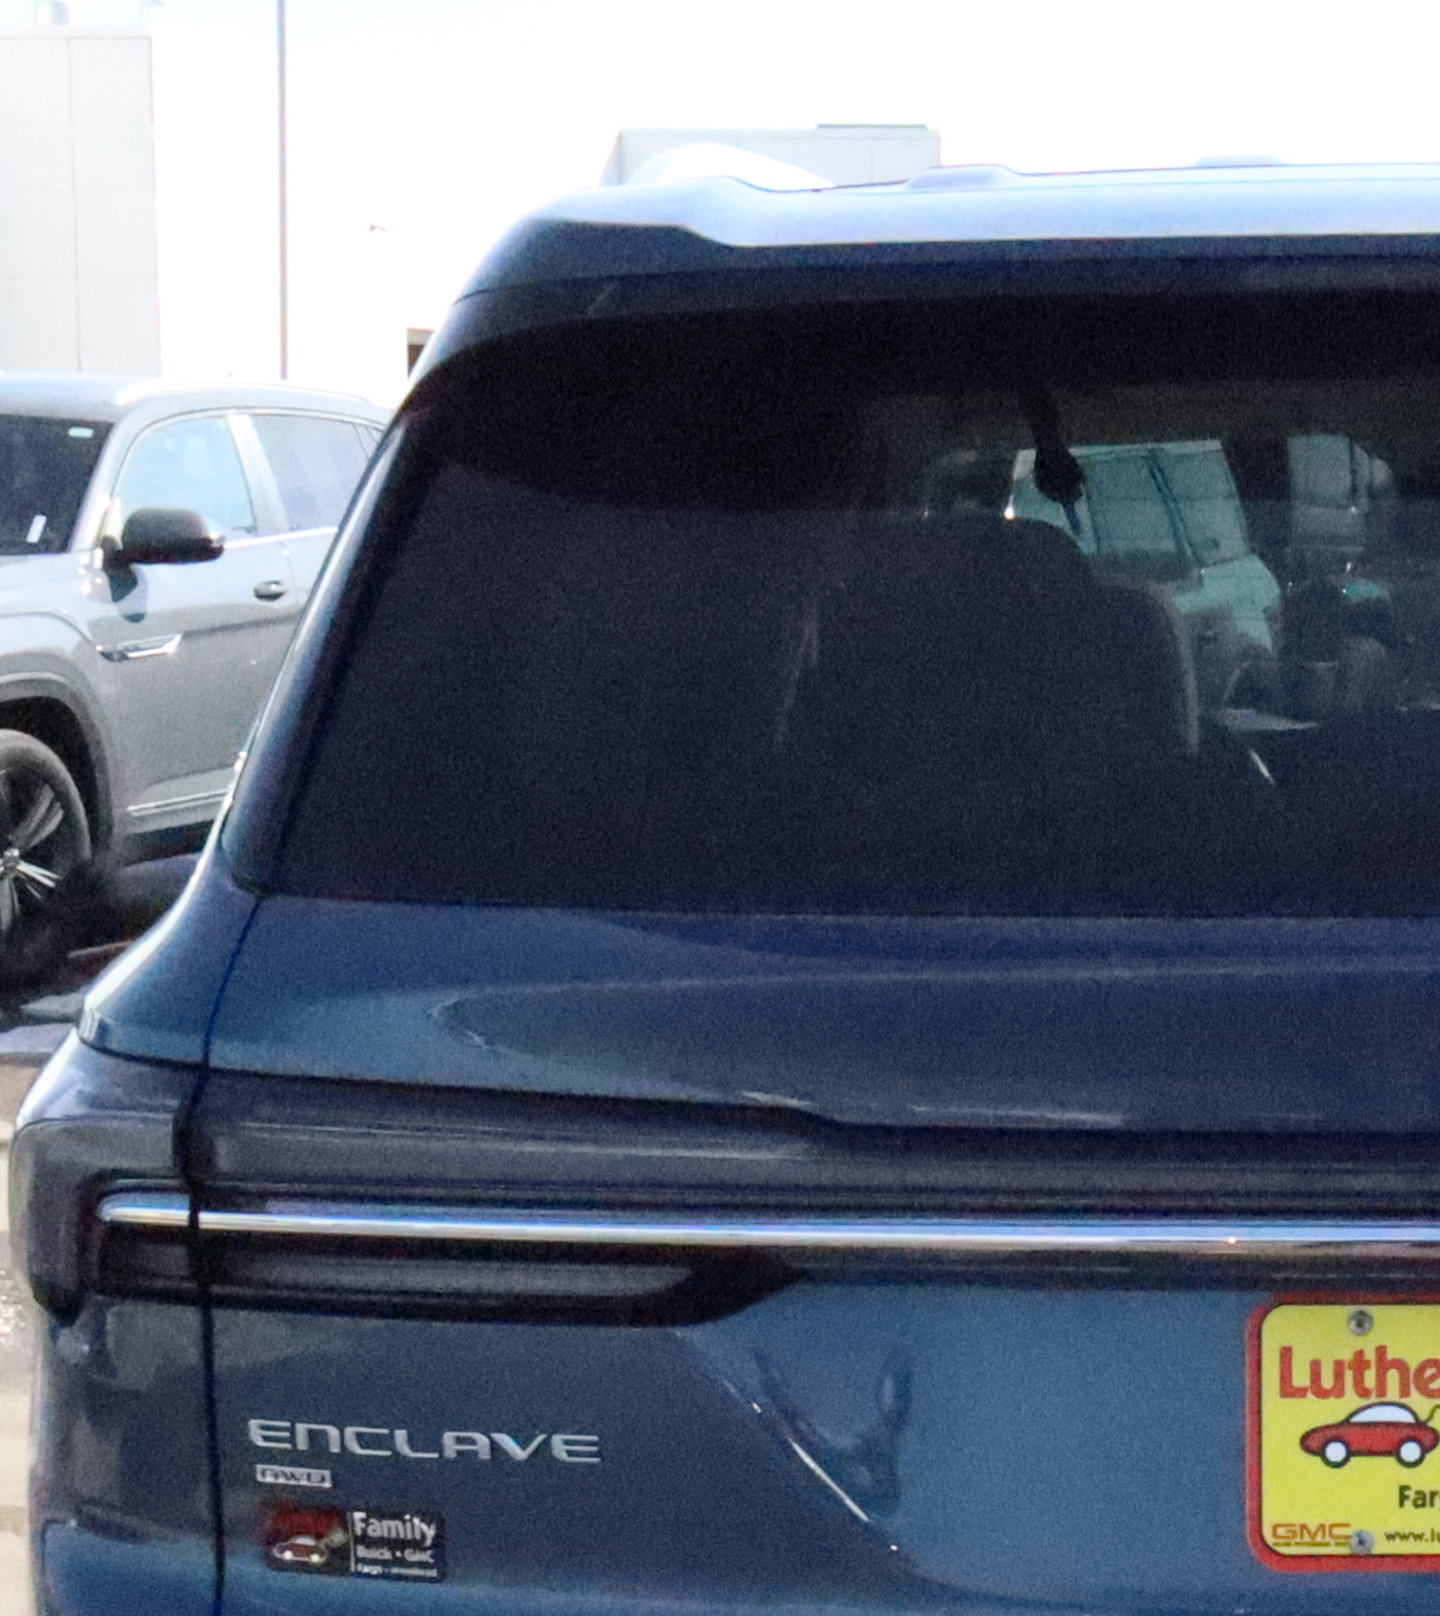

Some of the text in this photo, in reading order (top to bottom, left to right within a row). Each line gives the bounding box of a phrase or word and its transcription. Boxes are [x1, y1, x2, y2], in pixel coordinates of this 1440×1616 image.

[248, 1418, 602, 1464] ENCLAVE
[259, 1466, 328, 1485] AWD
[353, 1511, 437, 1546] Family
[1271, 1522, 1352, 1540] GMC
